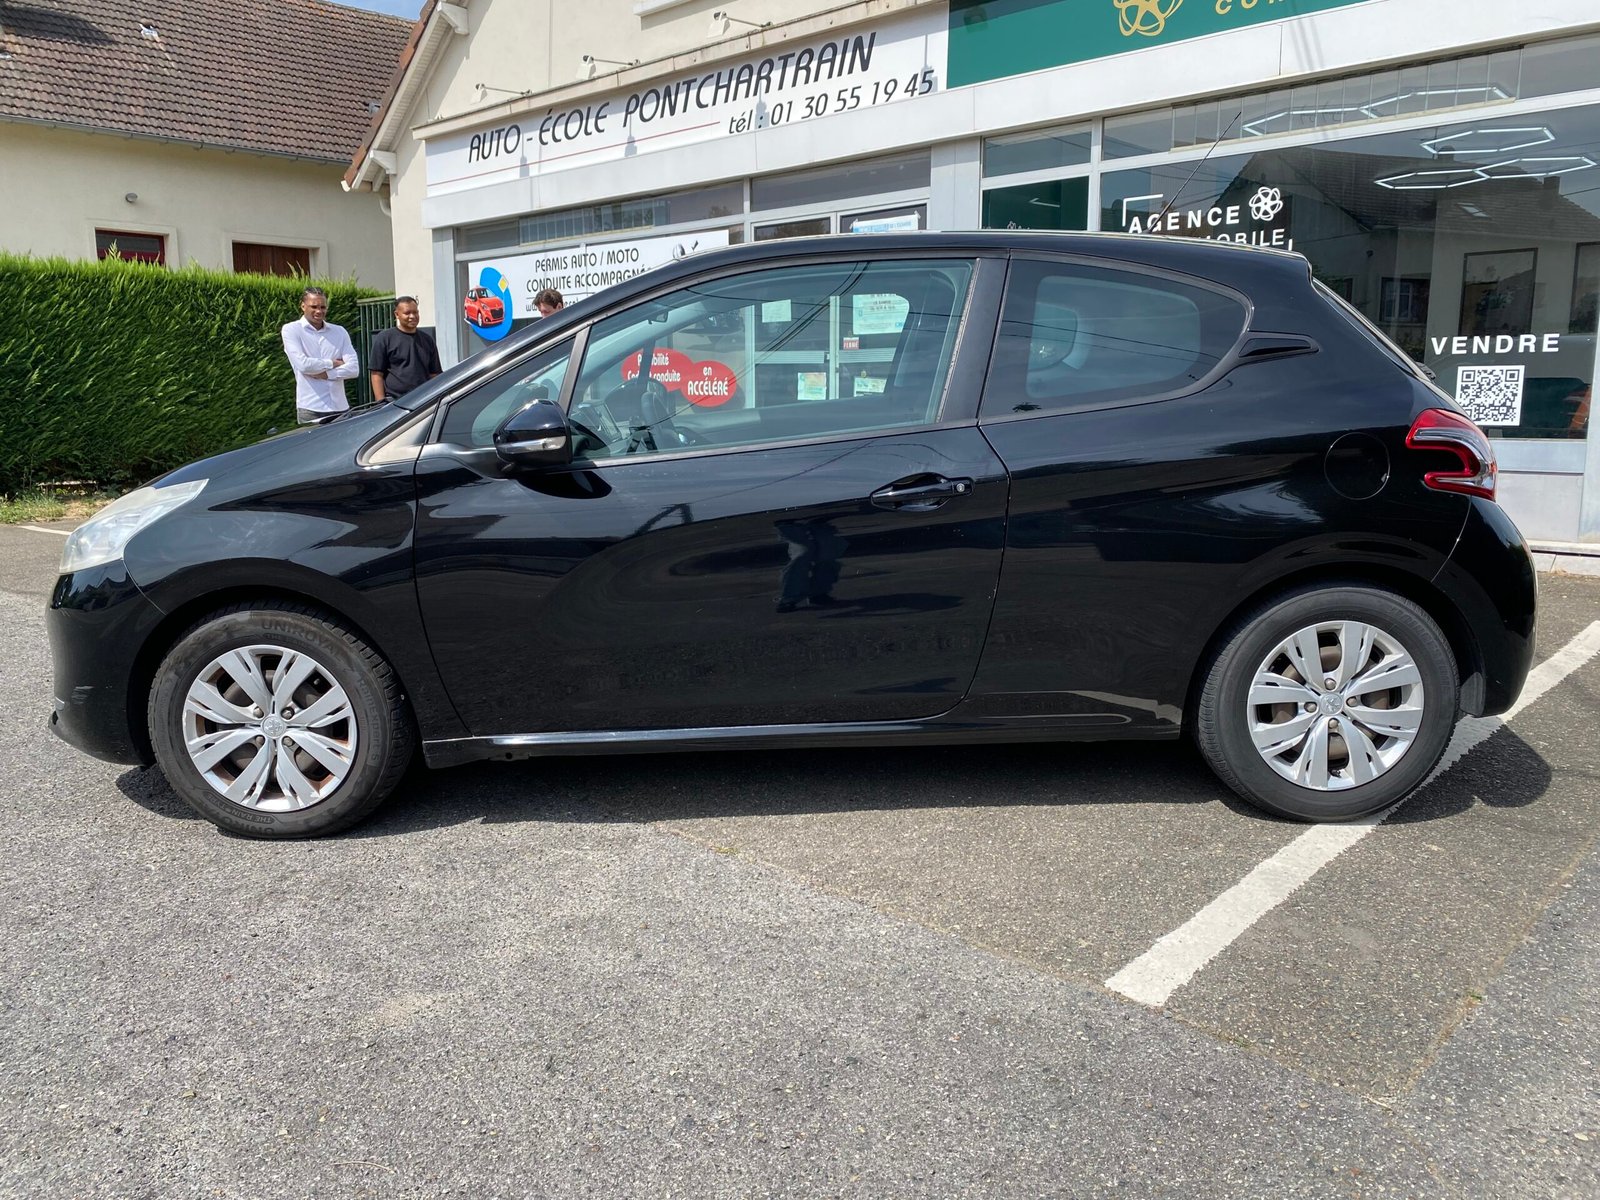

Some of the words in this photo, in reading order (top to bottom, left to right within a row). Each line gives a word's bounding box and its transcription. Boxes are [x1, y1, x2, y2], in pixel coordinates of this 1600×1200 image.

[622, 32, 877, 128] PONTCHARTRAIN
[771, 101, 793, 126] 01
[801, 93, 829, 119] 30
[834, 86, 862, 113] 55
[872, 78, 898, 105] 19
[904, 69, 935, 97] 45
[1128, 205, 1241, 234] AGENCE
[535, 256, 568, 273] PERMIS
[571, 252, 598, 269] AUTO
[606, 247, 640, 265] MOTO
[526, 275, 572, 293] CONDUITE
[574, 263, 651, 289] ACCOMPAGN
[1431, 333, 1560, 356] VENDRE
[702, 366, 713, 376] en
[687, 376, 729, 396] ACCÉLÉRÉ
[261, 619, 344, 660] UNIROYA
